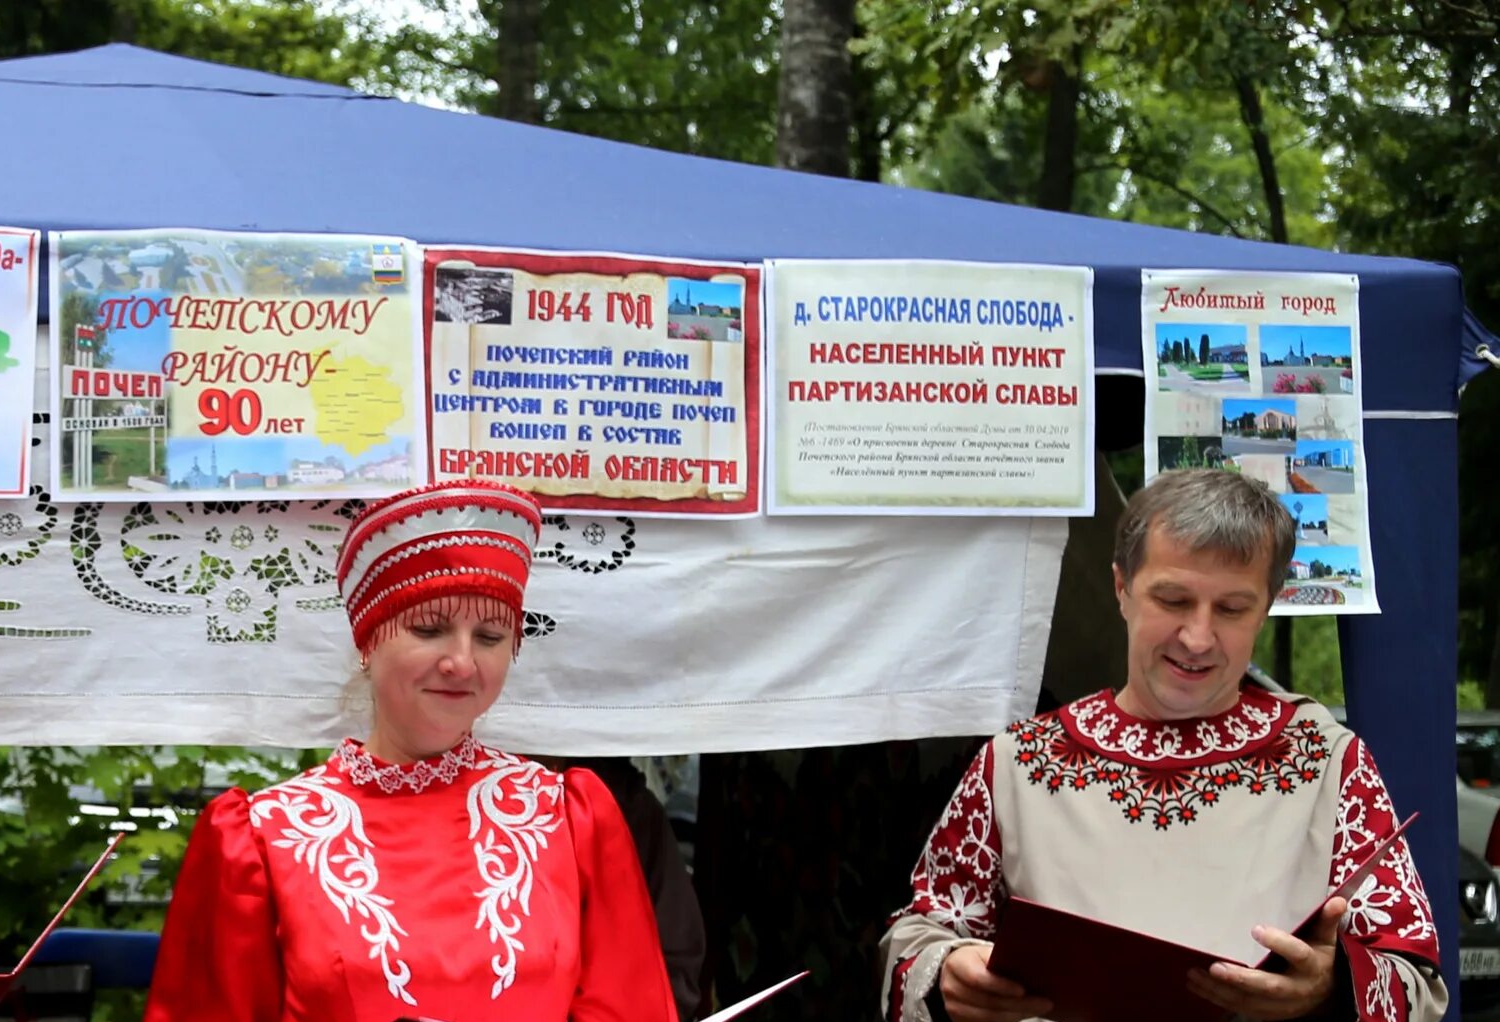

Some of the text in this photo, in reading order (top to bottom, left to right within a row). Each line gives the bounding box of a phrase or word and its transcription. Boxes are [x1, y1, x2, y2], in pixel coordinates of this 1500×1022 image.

[95, 296, 388, 336] ПОЧЕПСКОМУ
[527, 288, 654, 330] 1944 ГОД
[794, 302, 811, 327] д.
[818, 296, 971, 324] СТАРОКРАСНАЯ
[977, 299, 1064, 333] СЛОБОДА
[1160, 286, 1336, 316] Любимый город
[486, 344, 689, 371] ПОЧЕПСКИЙ РАЙОН
[810, 340, 1066, 369] НАСЕЛЕННЫЙ ПУНКТ
[72, 369, 162, 397] ПОЧЕП
[449, 368, 723, 398] С АДМИНИСТРАТИВНЫМ
[788, 378, 1078, 406] ПАРТИЗАНСКОЙ СЛАВЫ
[198, 388, 304, 437] 90 лет
[434, 393, 736, 424] ЦЕНТРОМ В ГОРОДЕ ПОЧЕП
[490, 421, 682, 445] ВОШЕЛ В СОСТАВ
[962, 439, 1030, 451] Старокрасная
[1035, 439, 1070, 451] Слобода
[439, 449, 738, 485] БРЯНСКОЙ ОБЛАСТИ
[799, 452, 856, 463] Почепского
[858, 452, 893, 464] района
[895, 451, 939, 465] Брянской
